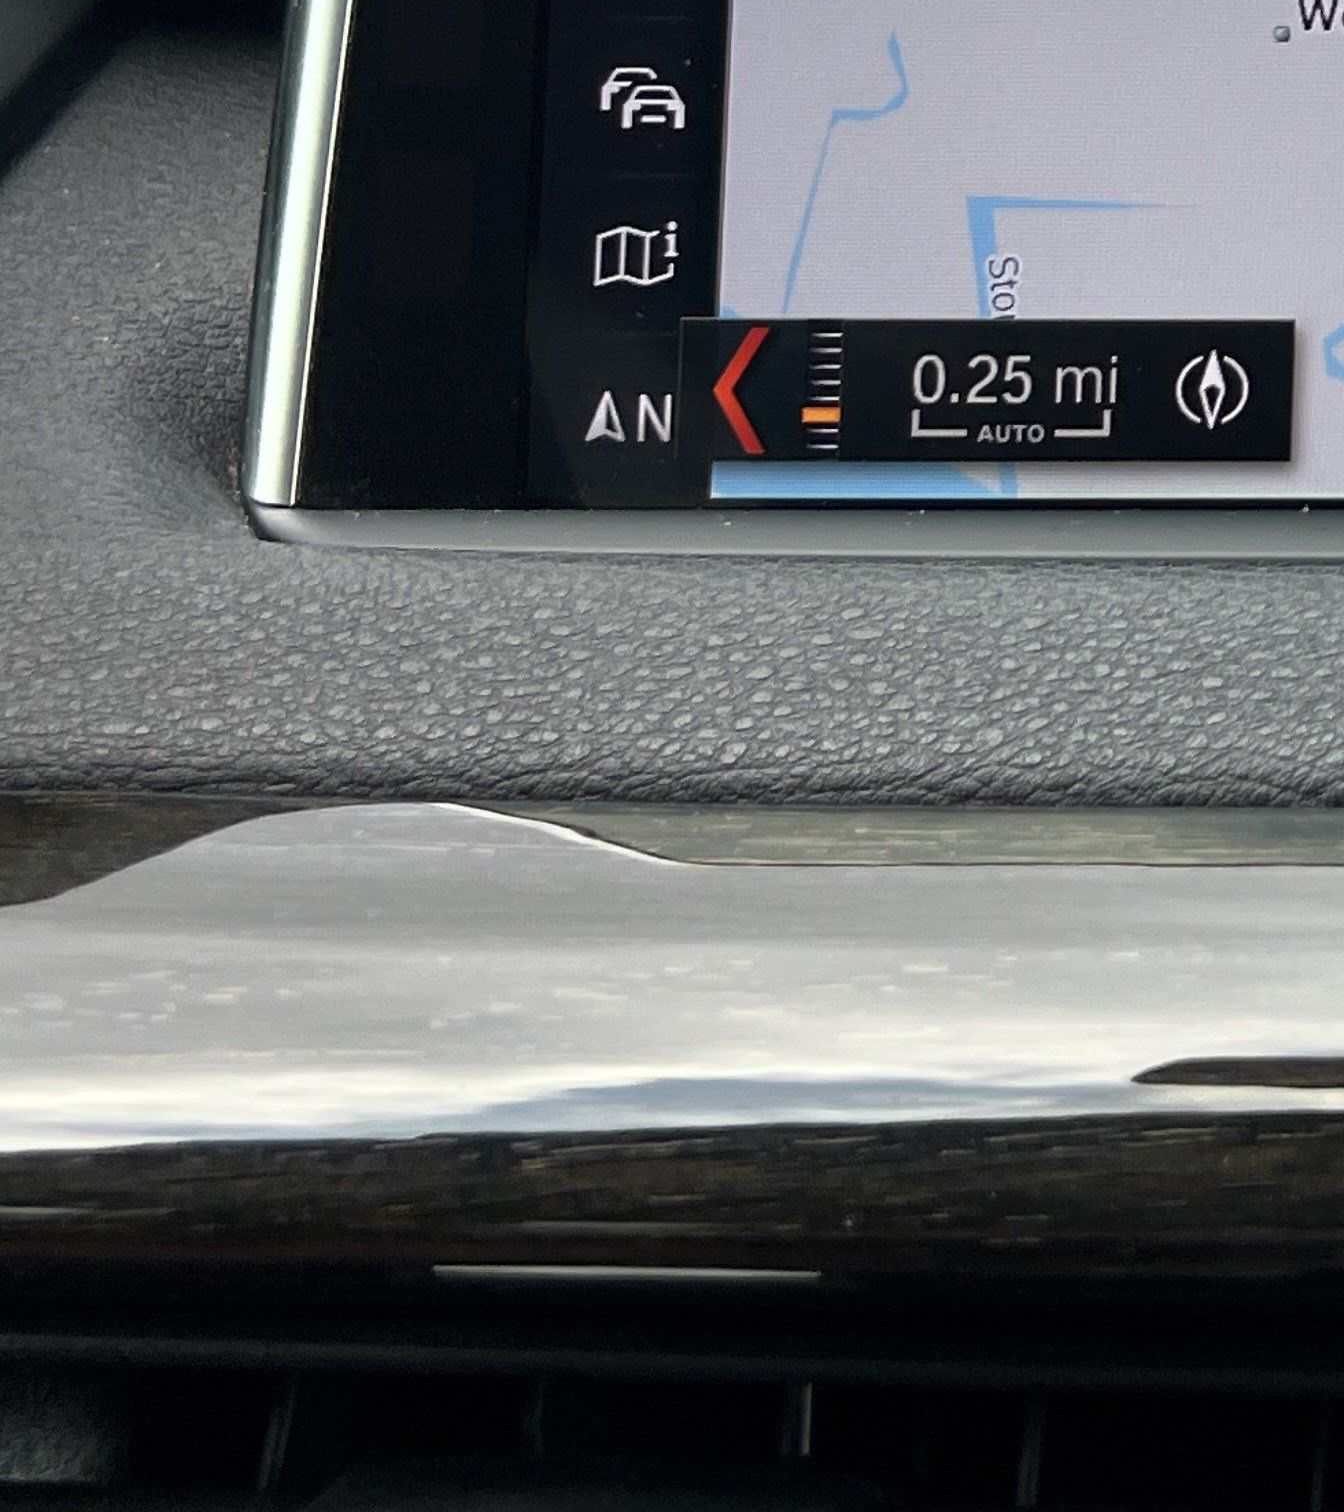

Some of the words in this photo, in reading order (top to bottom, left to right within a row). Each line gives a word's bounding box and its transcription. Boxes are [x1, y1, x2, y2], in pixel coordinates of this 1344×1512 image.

[912, 353, 1033, 405] 0.25
[1055, 354, 1119, 405] mi
[976, 423, 1047, 445] AUTO
